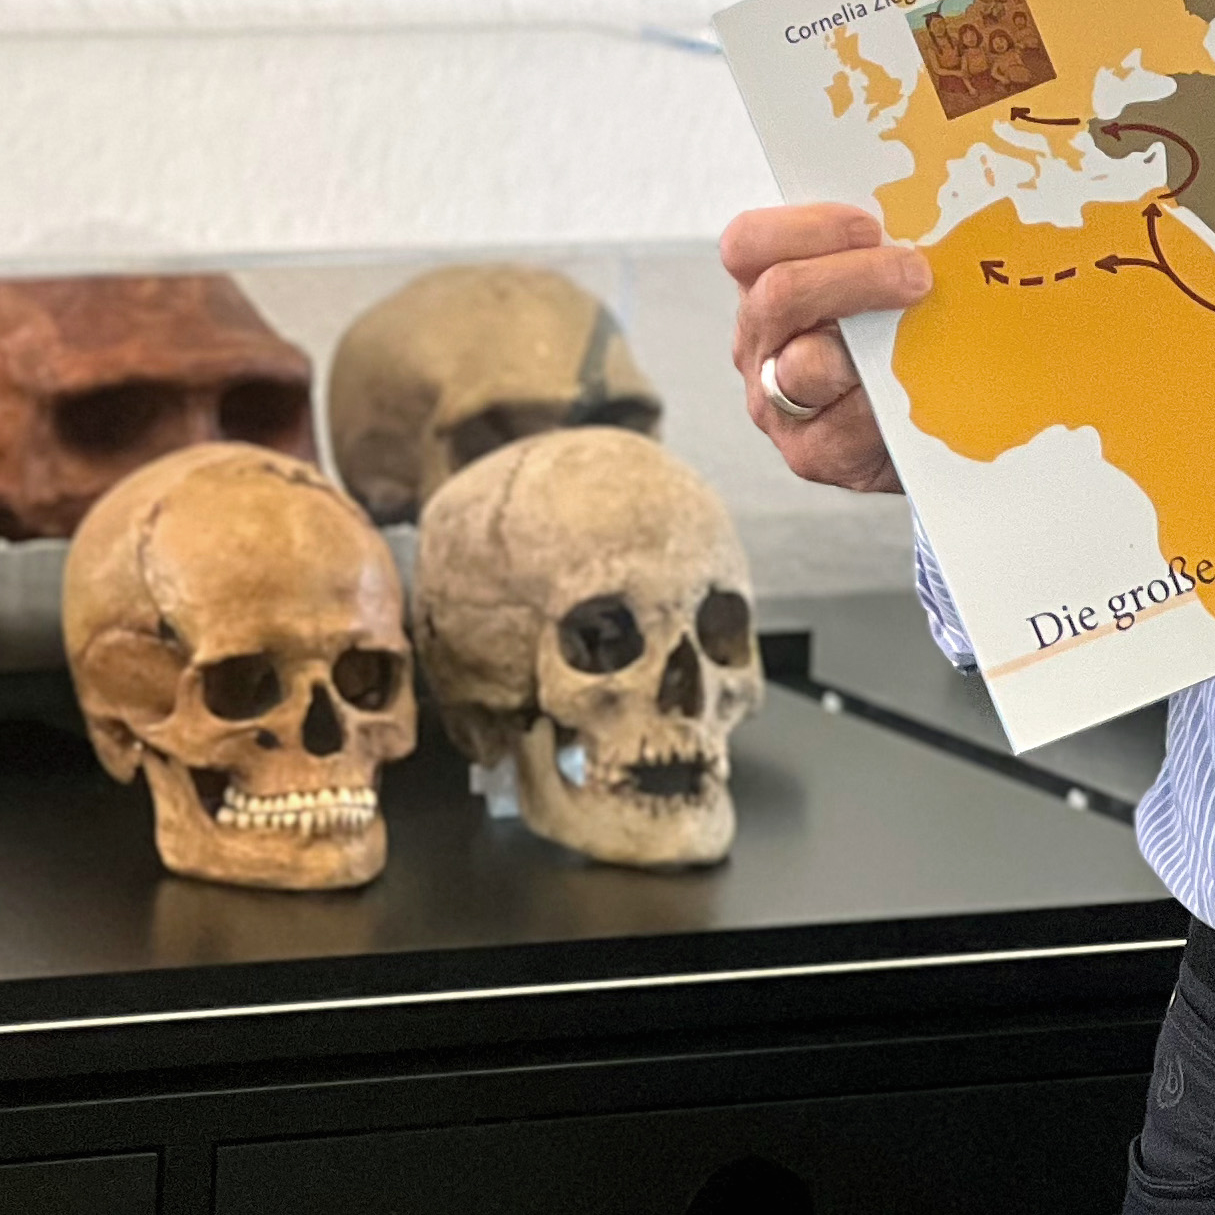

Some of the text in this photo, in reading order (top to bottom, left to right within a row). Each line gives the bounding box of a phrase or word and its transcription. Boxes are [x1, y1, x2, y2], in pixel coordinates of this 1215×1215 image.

[785, 3, 868, 44] Cornelia
[1026, 605, 1099, 650] Die
[1108, 556, 1215, 631] große
